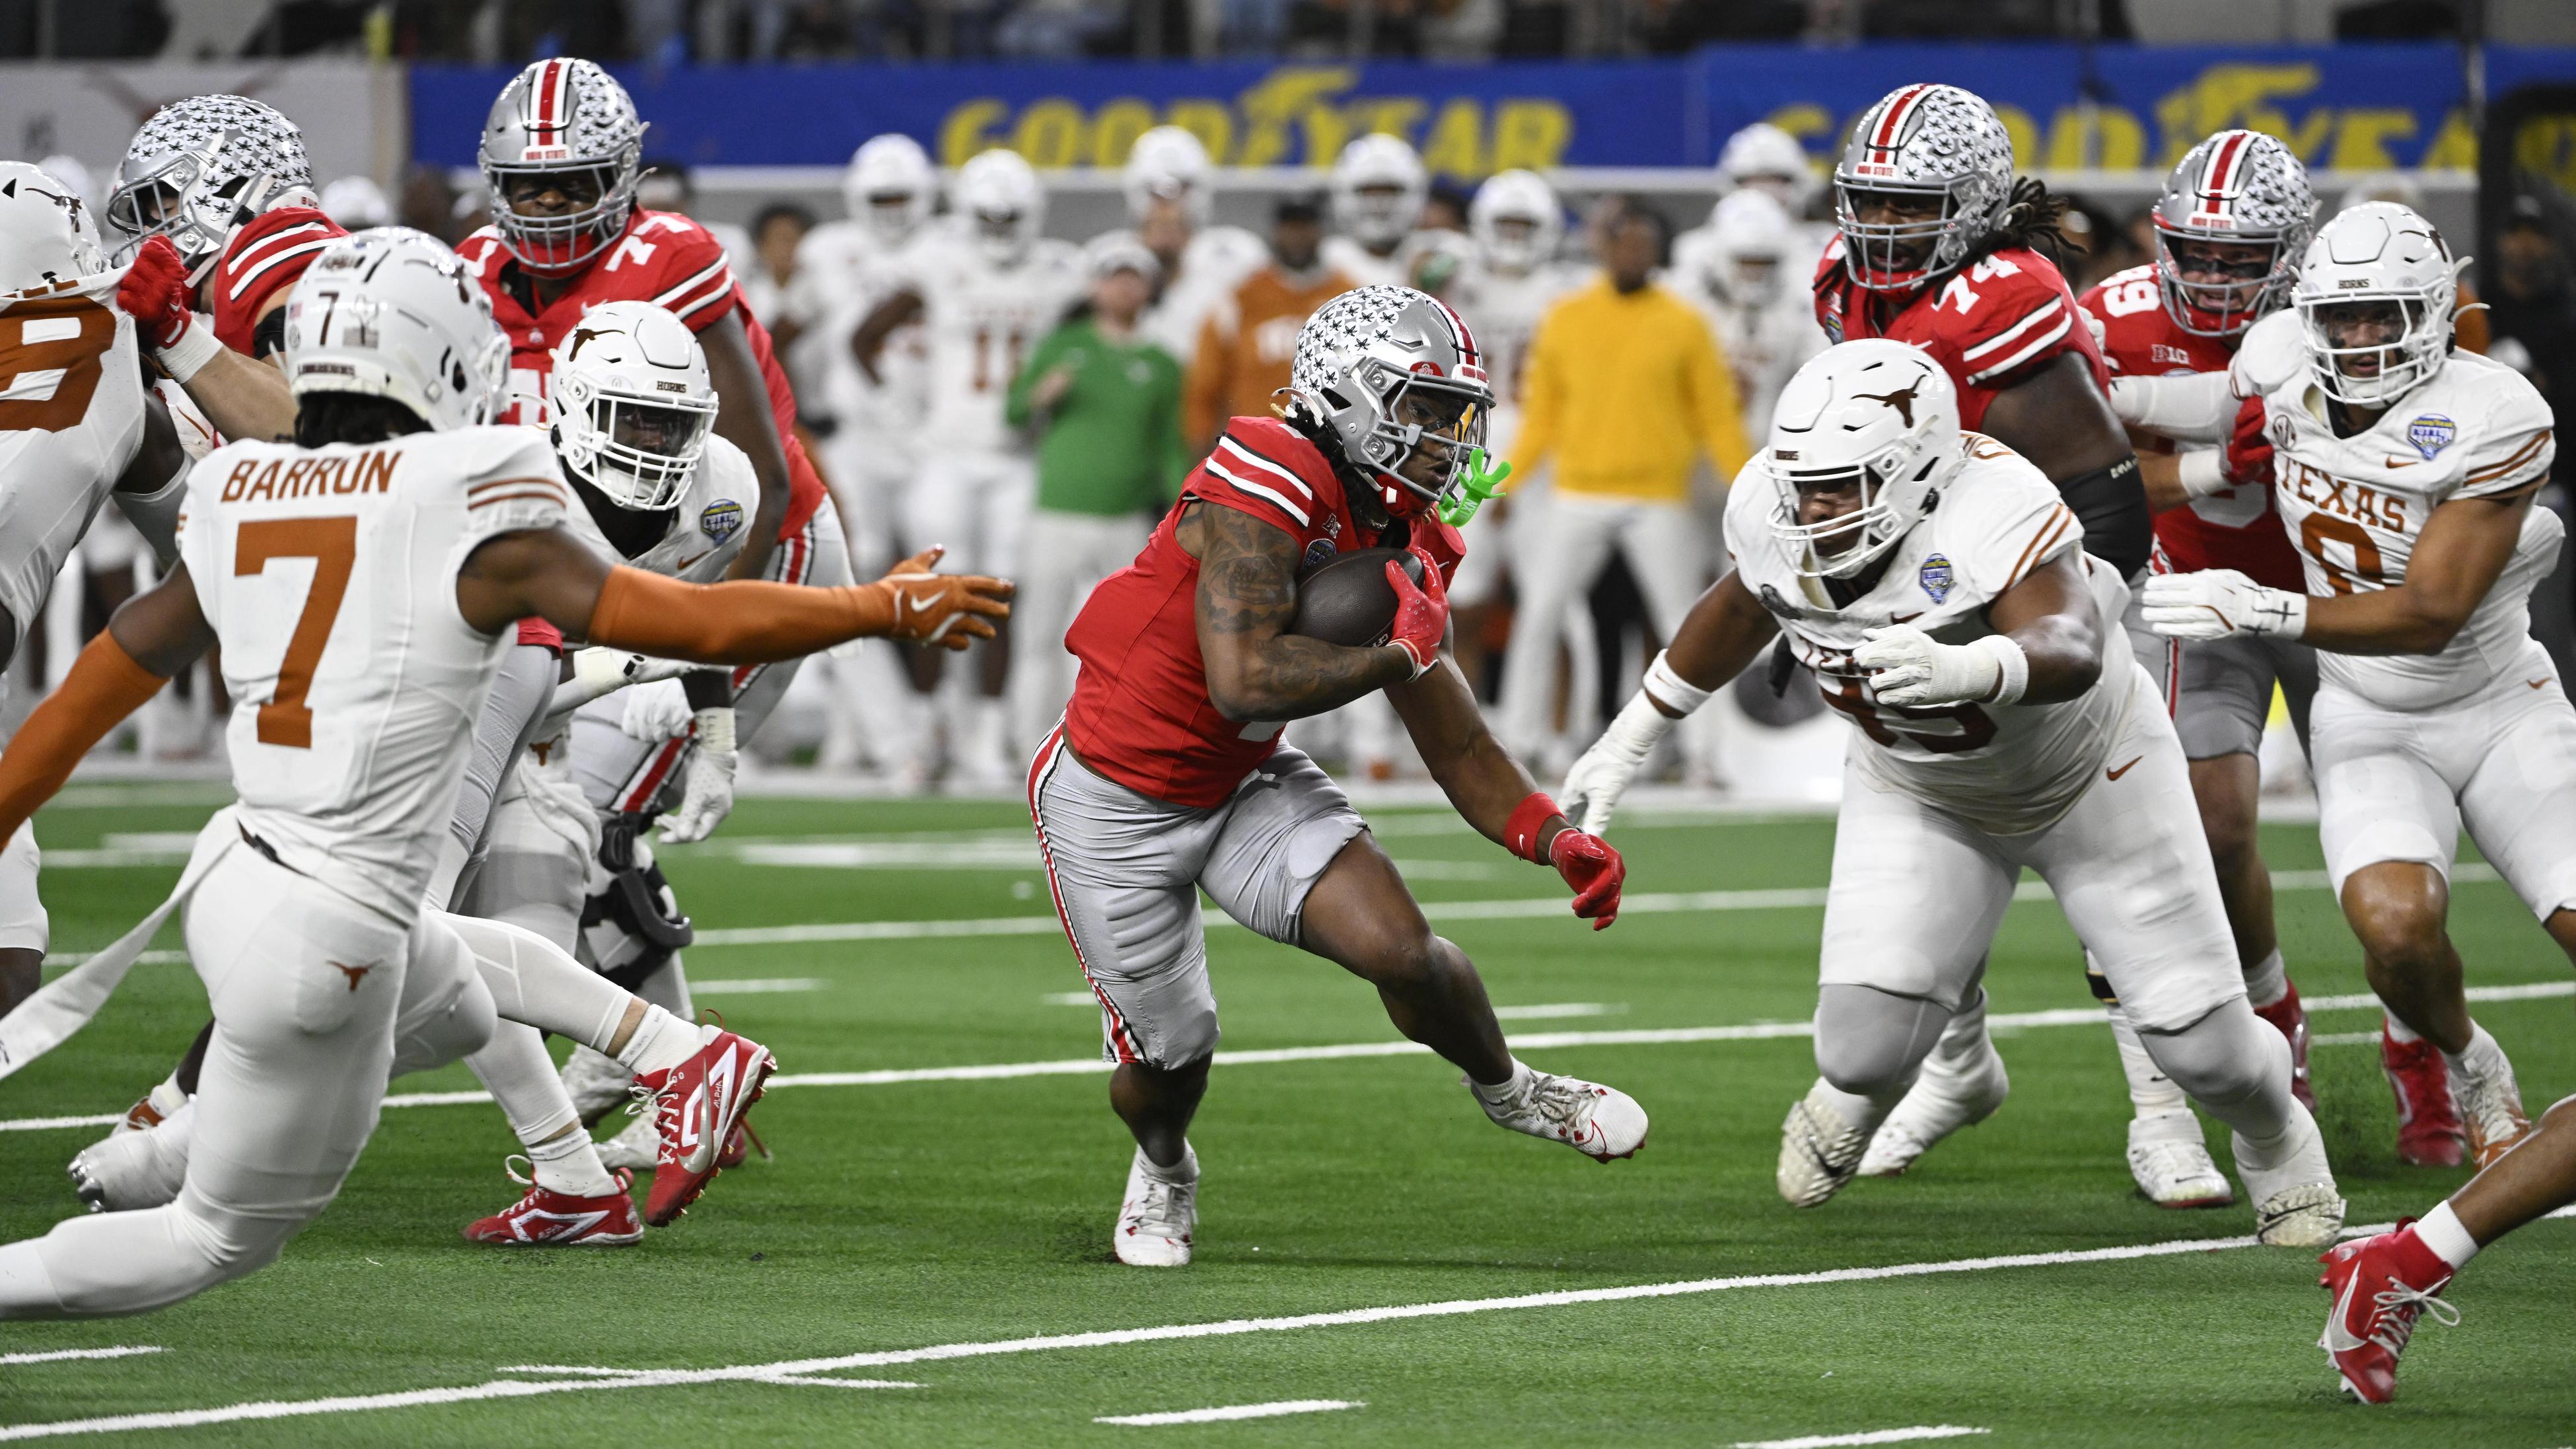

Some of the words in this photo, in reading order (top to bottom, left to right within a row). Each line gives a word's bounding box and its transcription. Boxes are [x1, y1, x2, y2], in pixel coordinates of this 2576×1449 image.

[318, 291, 340, 346] 7
[221, 450, 404, 503] BARRON
[2282, 457, 2406, 534] TEXAS
[234, 514, 357, 750] 7
